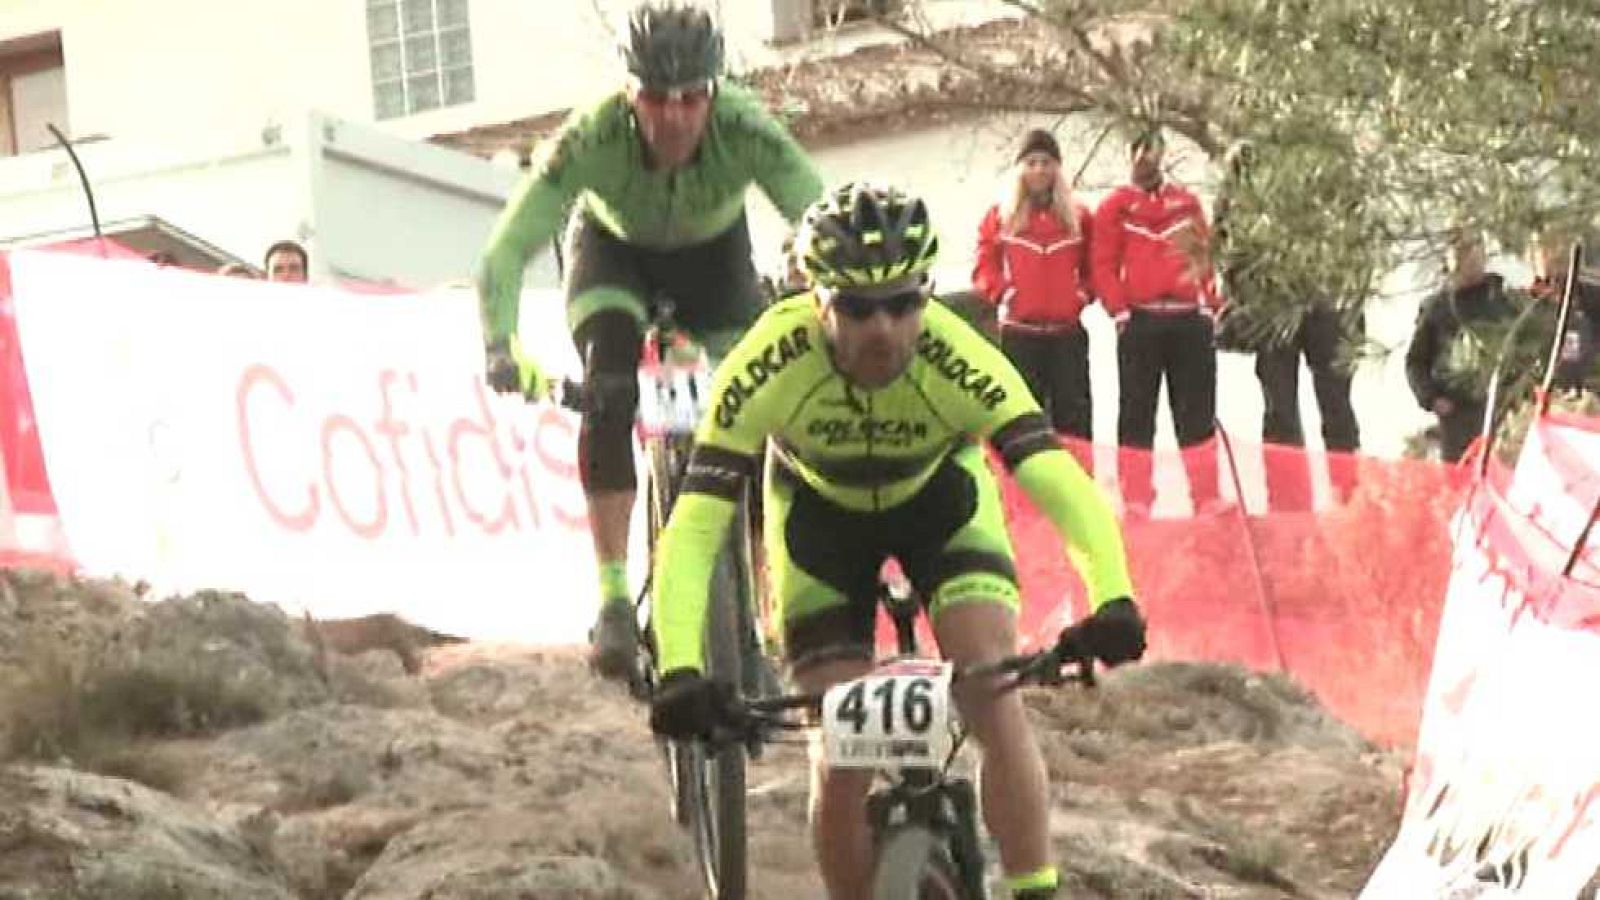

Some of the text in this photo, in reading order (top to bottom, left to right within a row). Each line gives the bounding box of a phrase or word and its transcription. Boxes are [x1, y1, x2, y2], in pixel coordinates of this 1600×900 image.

[715, 325, 811, 428] GOLDCAR
[917, 329, 1007, 410] GOLDCAR
[236, 363, 591, 537] Cofidis
[836, 677, 933, 734] 416
